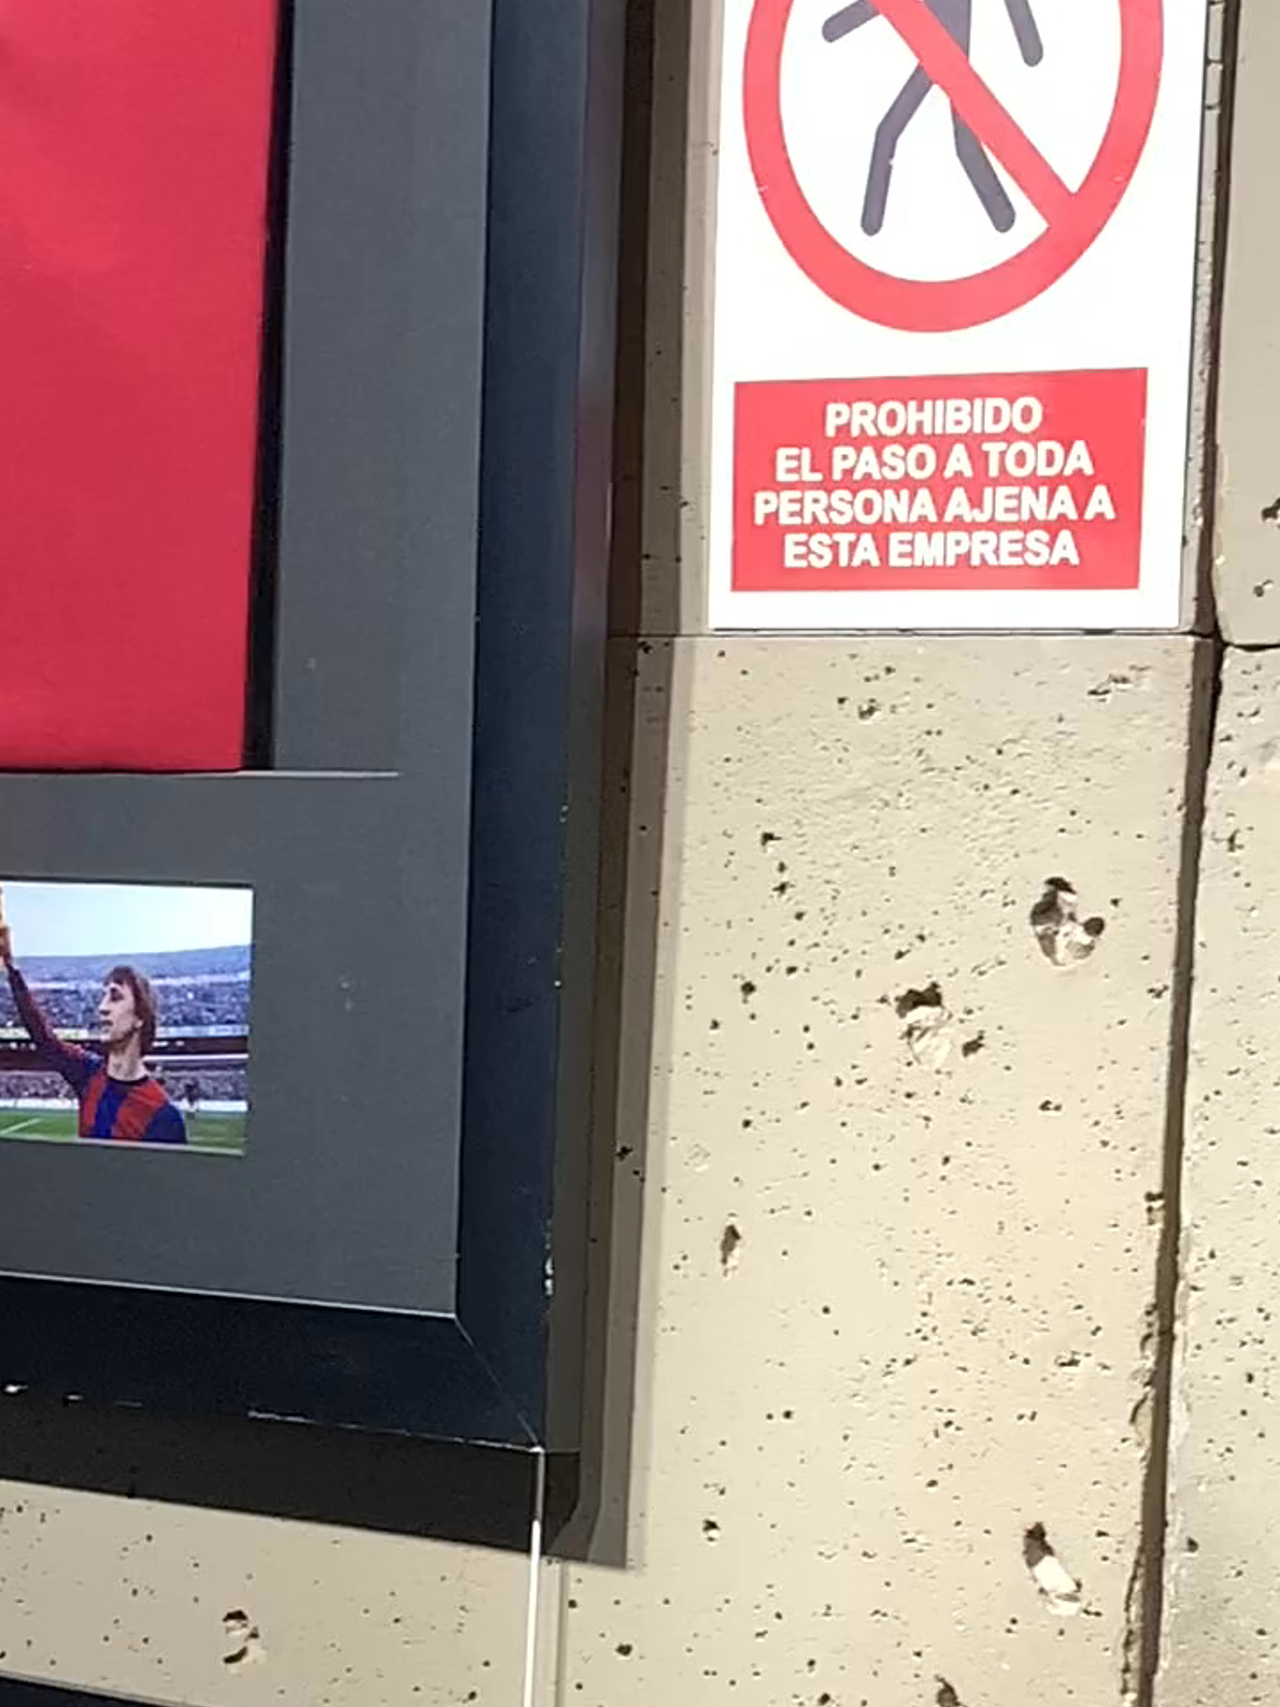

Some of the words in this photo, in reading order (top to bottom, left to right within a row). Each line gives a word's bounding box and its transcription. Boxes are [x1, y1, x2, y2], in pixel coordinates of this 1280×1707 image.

[825, 396, 1042, 437] PROHIBIDO
[776, 448, 822, 483] EL
[832, 443, 936, 481] PASO
[943, 442, 973, 479] A
[981, 439, 1095, 477] TODA
[754, 488, 937, 525] PERSONA
[944, 485, 1077, 523] AJENA
[1084, 484, 1116, 520] A
[783, 533, 881, 569] ESTA
[888, 529, 1080, 567] EMPRESA
